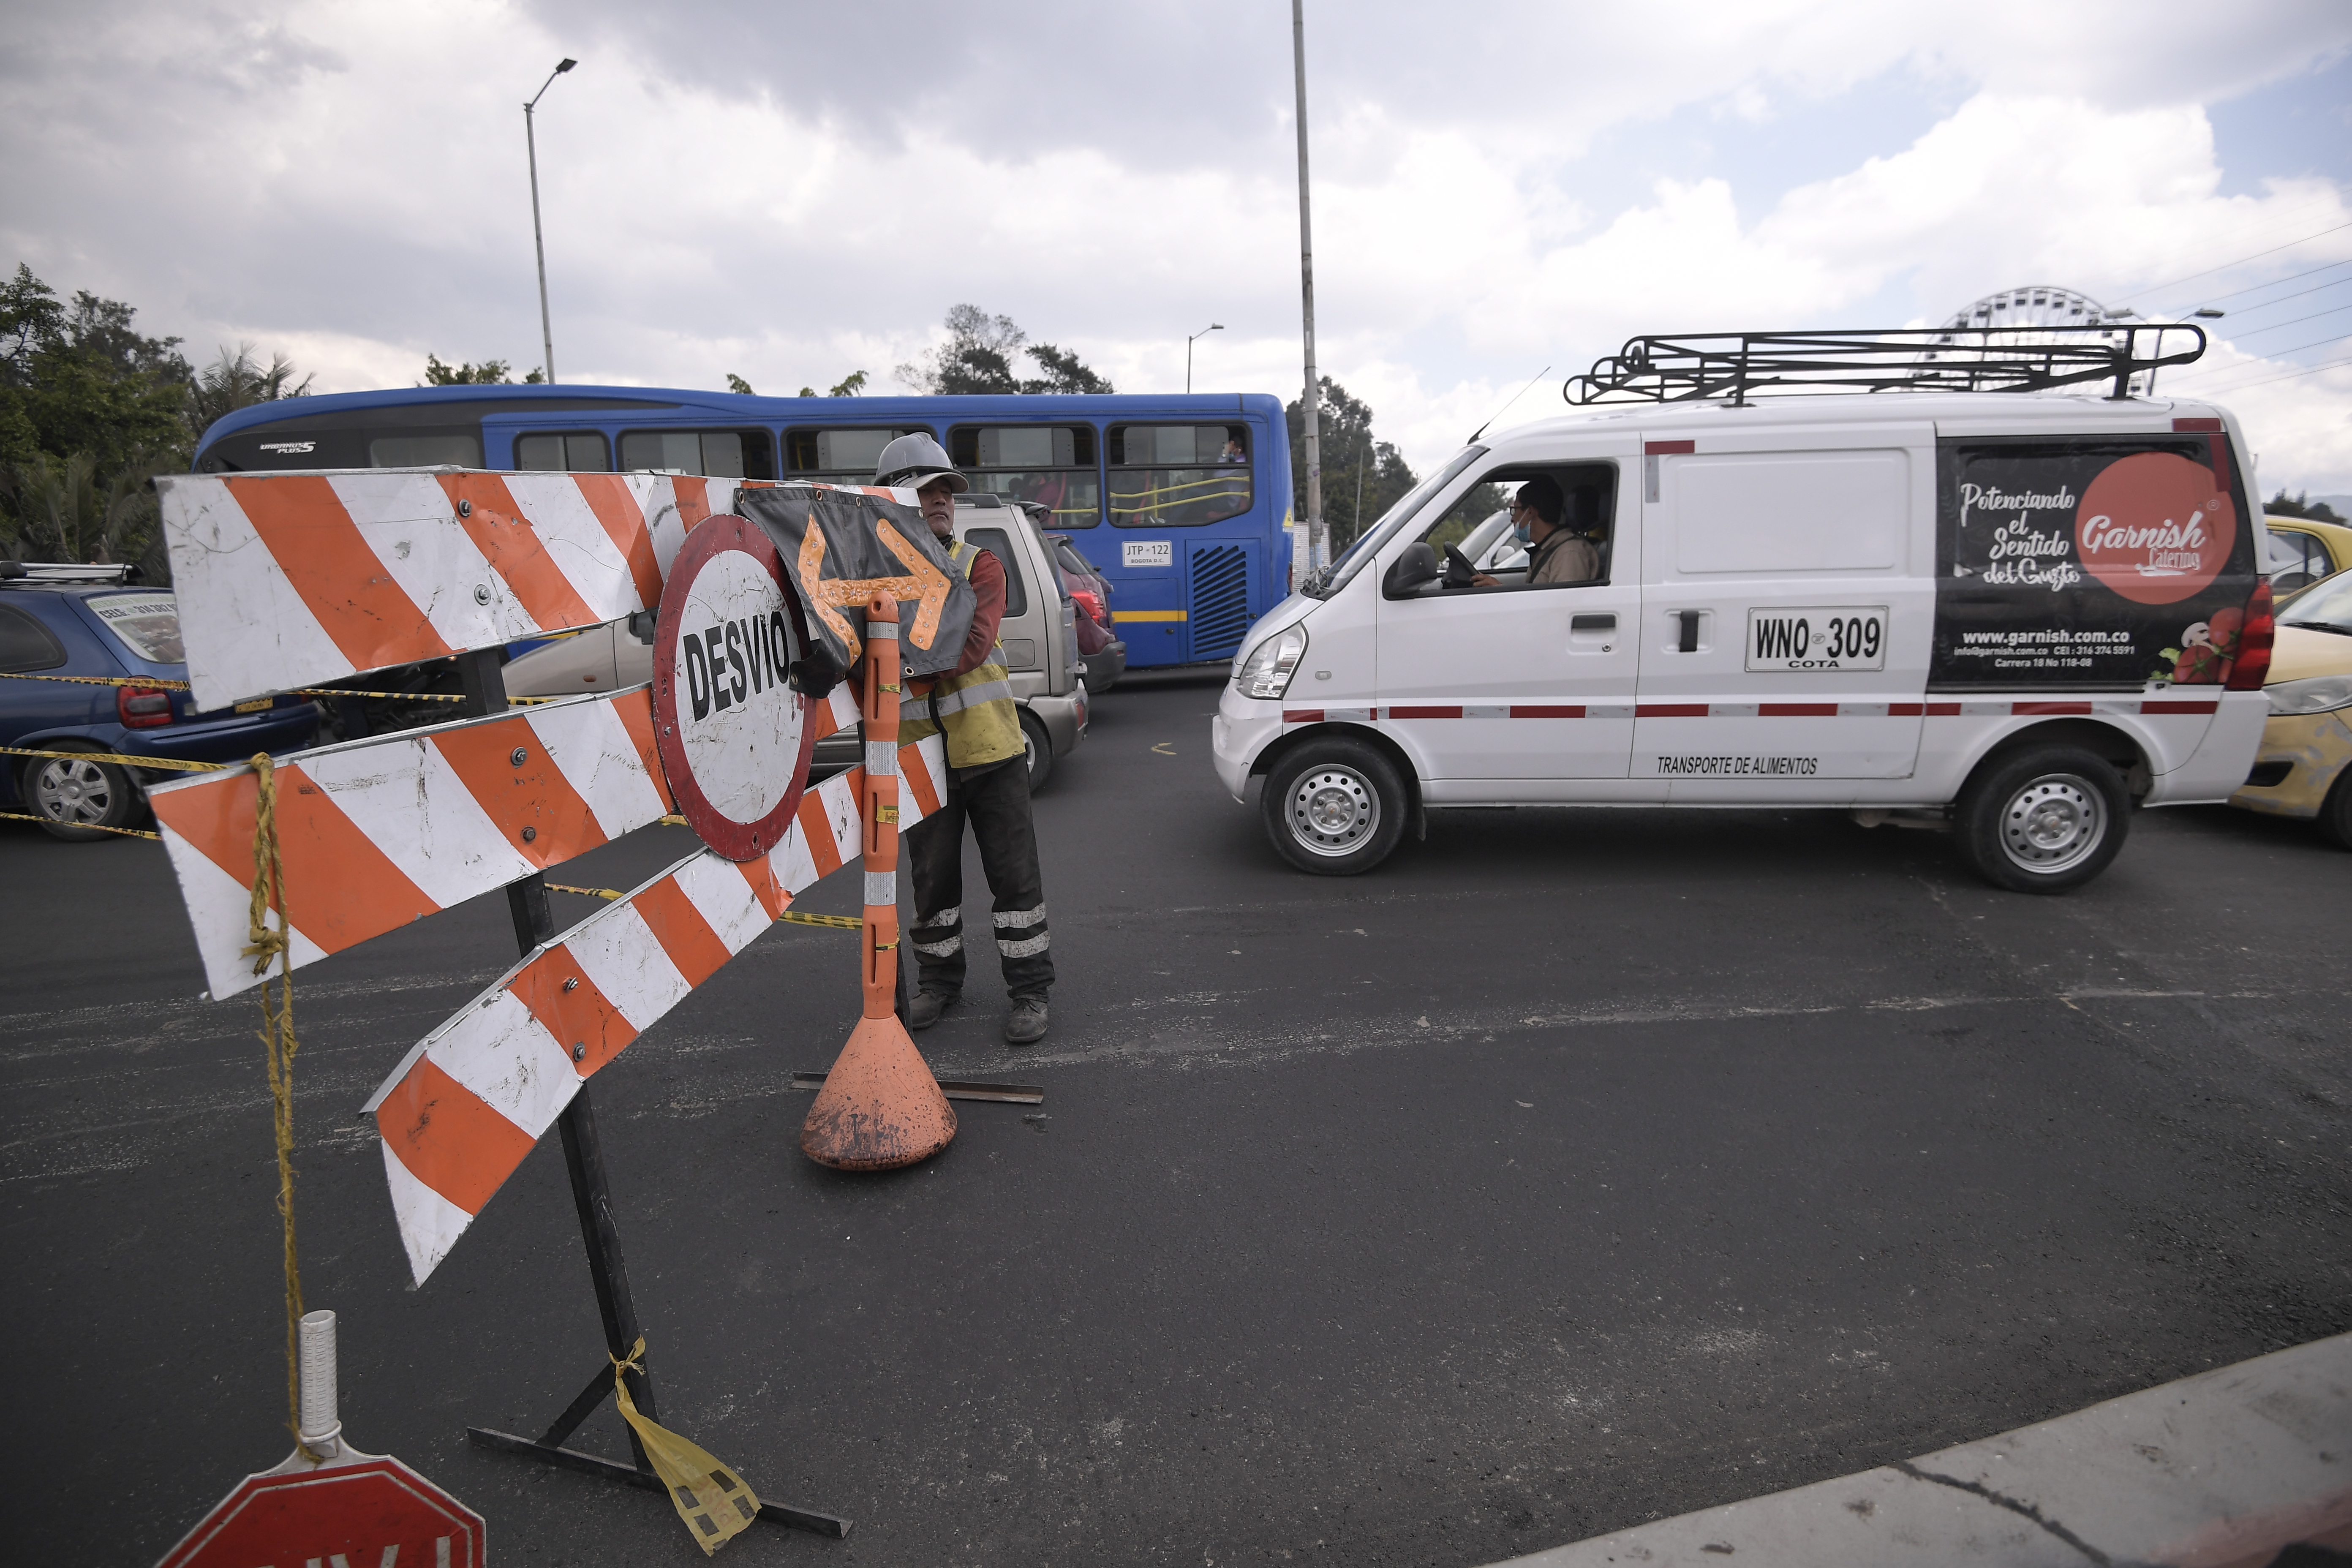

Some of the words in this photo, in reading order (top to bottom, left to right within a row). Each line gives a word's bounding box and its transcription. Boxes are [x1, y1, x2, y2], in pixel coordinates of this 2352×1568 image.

[1960, 482, 2075, 527] Potenciando
[2008, 510, 2028, 535] el
[2081, 510, 2206, 554] Garnish
[1127, 545, 1143, 555] JTP
[1152, 544, 1169, 555] 122
[1989, 527, 2070, 560] Sentido
[2149, 547, 2200, 570] Catering
[1983, 561, 2019, 584] del
[1756, 618, 1810, 659] WNO
[1827, 617, 1881, 658] 309
[1962, 629, 2130, 646] www.garnish.com.co
[1953, 646, 2048, 658] info@garnish.com.co
[2076, 645, 2093, 655] 316
[2094, 645, 2112, 655] 374
[2112, 645, 2135, 655] 5591
[1994, 658, 2032, 667] Carrera
[2045, 657, 2060, 667] No
[683, 610, 789, 722] DESVIO
[1788, 660, 1840, 668] COTA
[1658, 756, 1732, 773] TRANSPORTE
[1734, 757, 1751, 773] DE
[1751, 757, 1818, 774] ALIMENTOS
